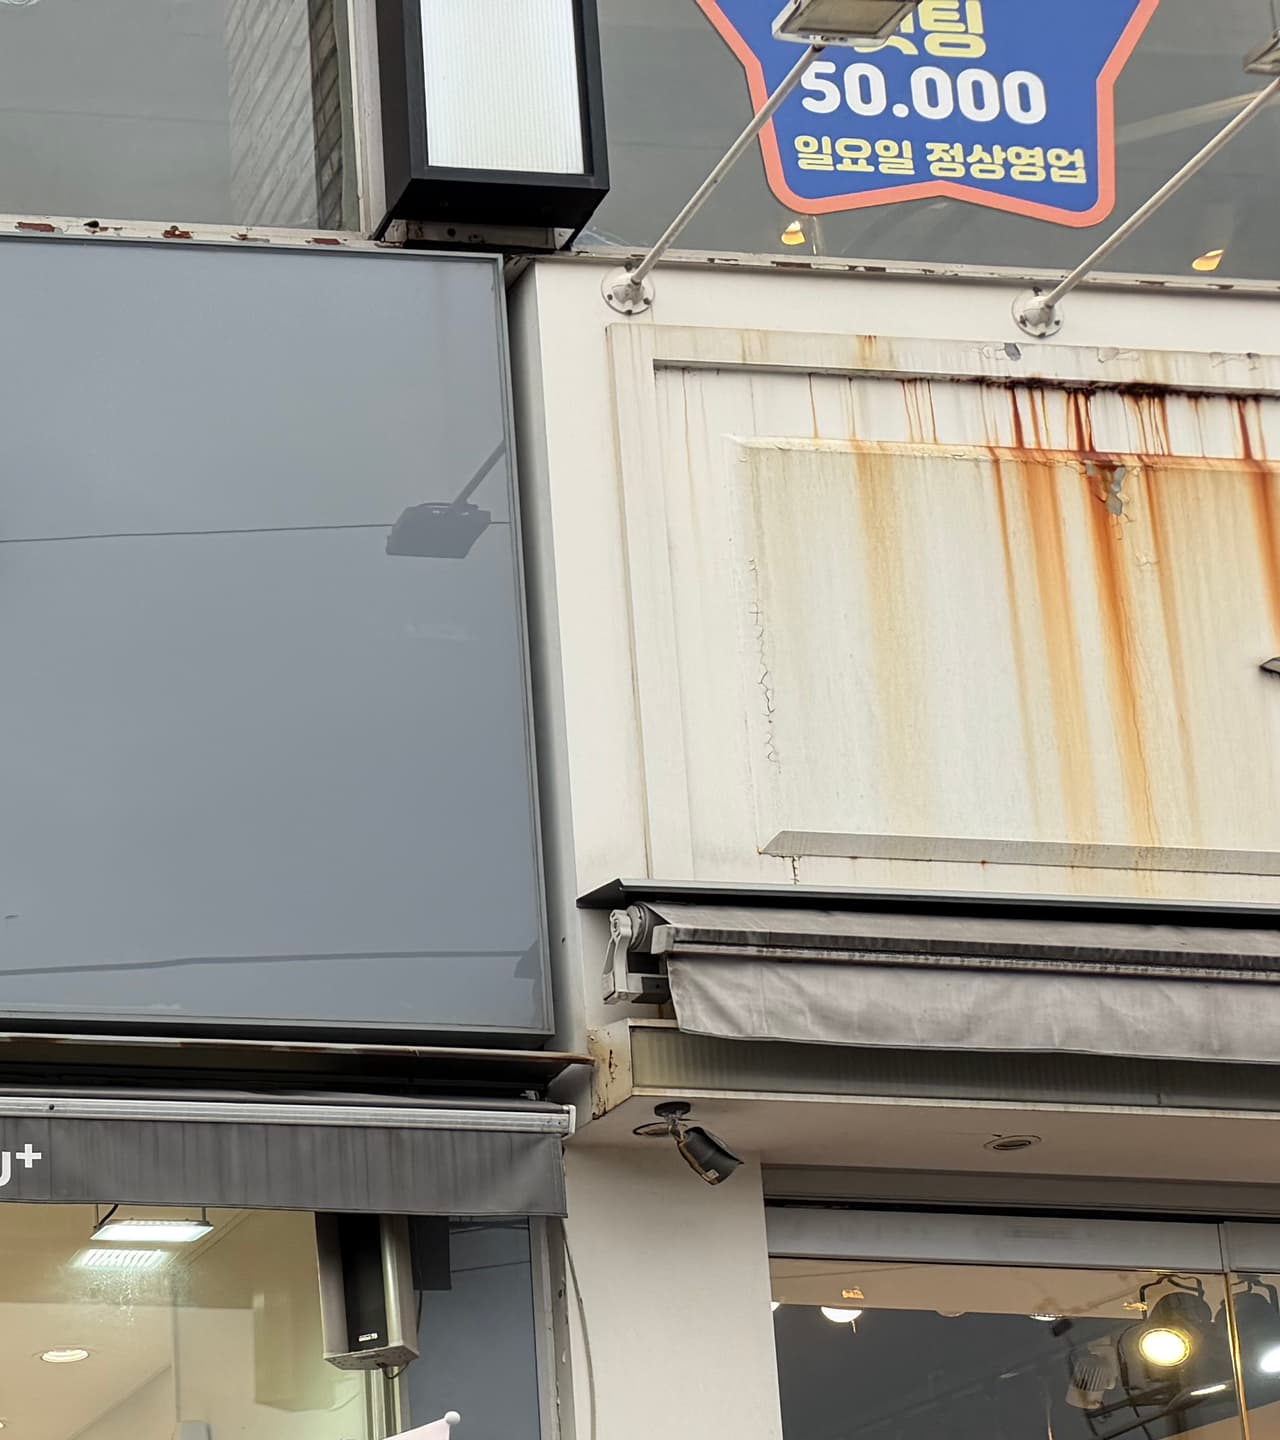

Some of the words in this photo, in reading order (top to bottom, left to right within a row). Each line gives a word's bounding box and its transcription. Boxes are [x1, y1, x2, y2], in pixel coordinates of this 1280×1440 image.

[799, 60, 1047, 126] 50.000
[793, 135, 915, 175] 일요일
[925, 142, 1088, 185] 정상영업
